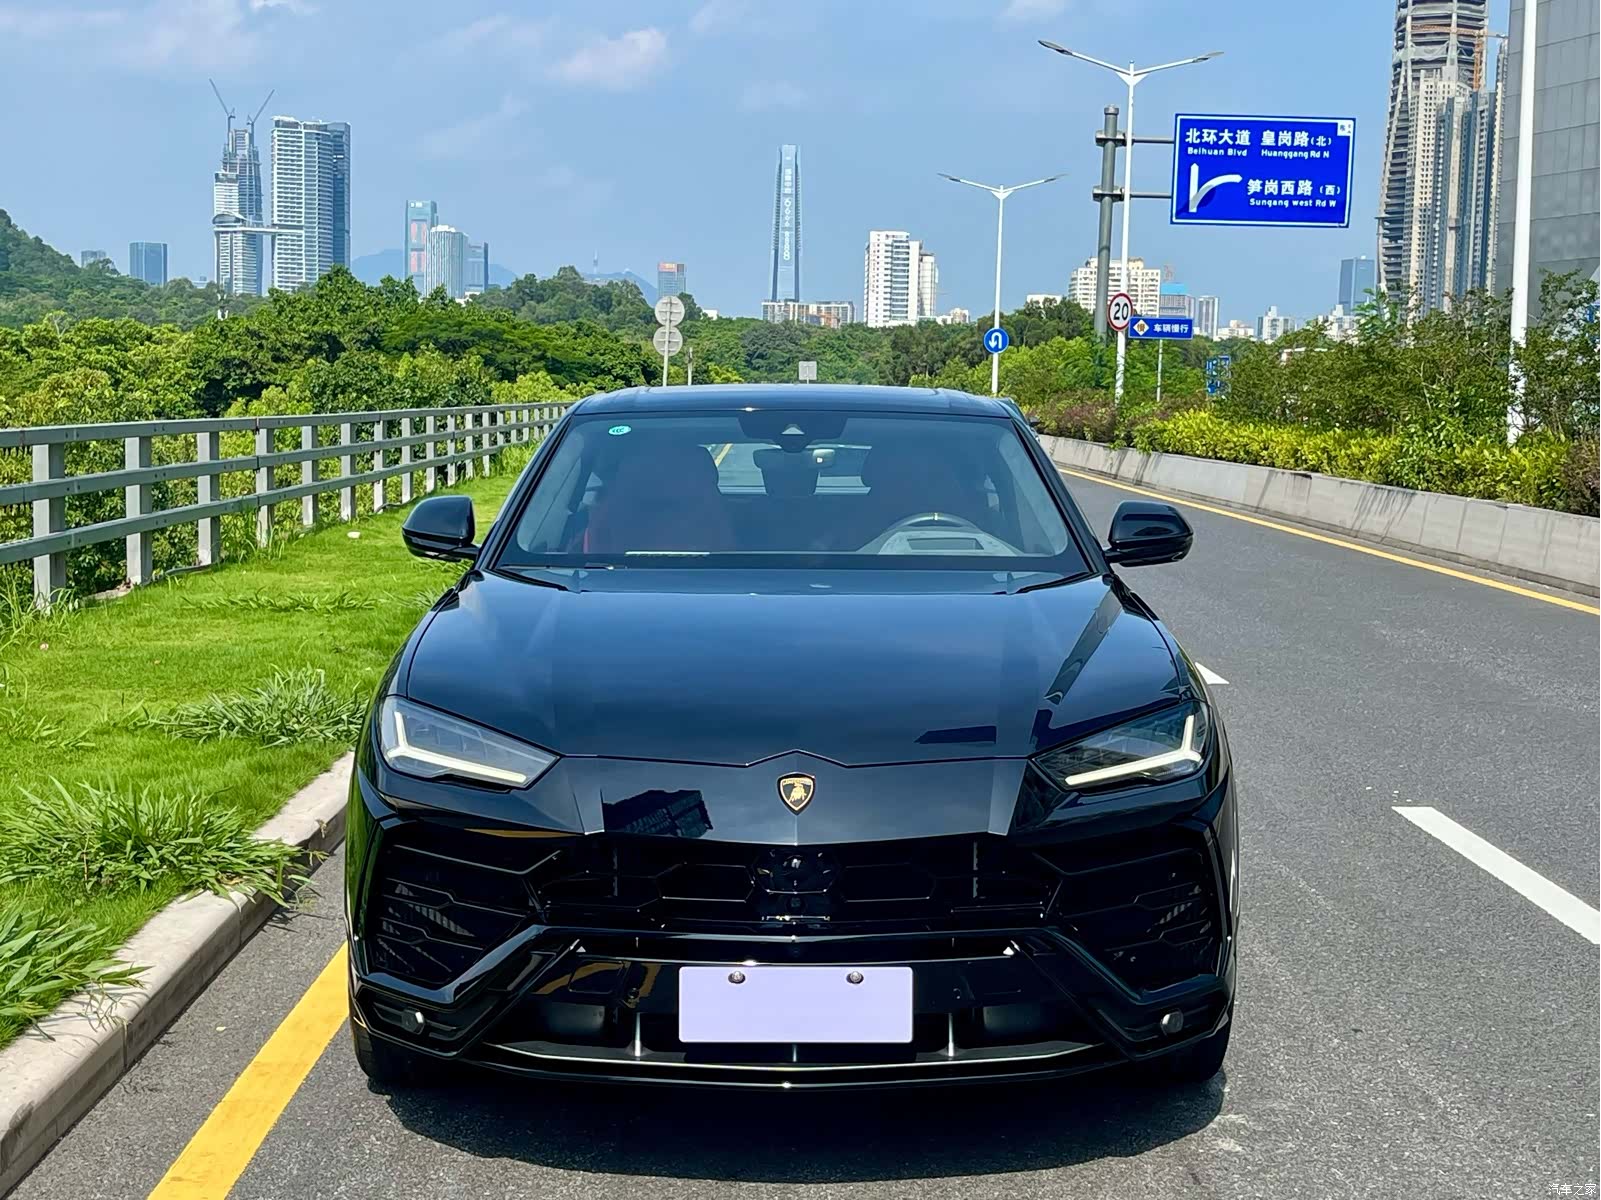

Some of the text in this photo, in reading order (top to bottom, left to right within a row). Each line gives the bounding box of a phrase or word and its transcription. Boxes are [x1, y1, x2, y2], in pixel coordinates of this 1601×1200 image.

[1185, 128, 1251, 145] 北环大道
[1187, 147, 1330, 160] Beihuan Blvd Huanggang Rd N
[1249, 198, 1337, 208] Sungang west Rd W
[1113, 302, 1129, 321] 20
